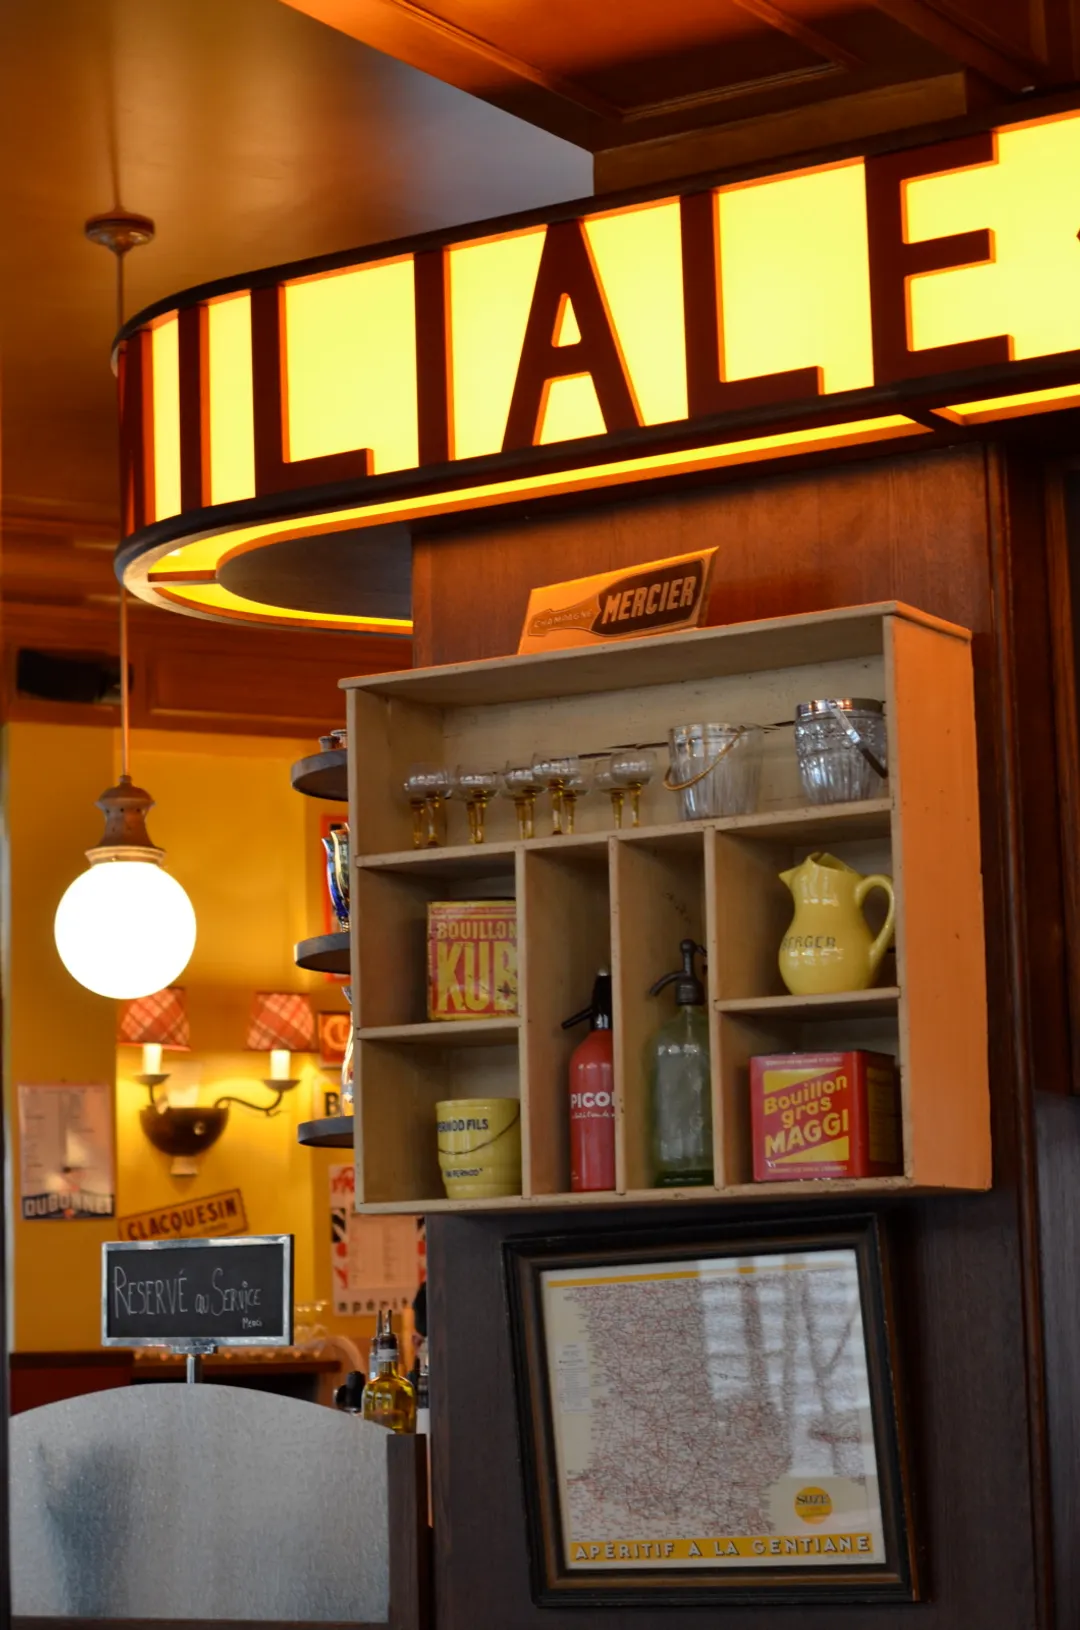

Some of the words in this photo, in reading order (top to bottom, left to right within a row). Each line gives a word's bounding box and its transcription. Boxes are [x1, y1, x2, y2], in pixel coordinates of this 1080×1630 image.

[602, 575, 696, 624] MERCIER
[437, 941, 518, 1012] KUB
[570, 1091, 617, 1109] PICO
[764, 1075, 847, 1116] Bouillon
[781, 1097, 832, 1129] gras
[467, 1119, 489, 1130] FILS
[764, 1109, 849, 1158] MAGGI
[127, 1198, 237, 1240] CLACQUESIN
[575, 1541, 675, 1561] APÉRITIF
[713, 1540, 740, 1556] LA
[752, 1535, 870, 1555] GENTIANE
